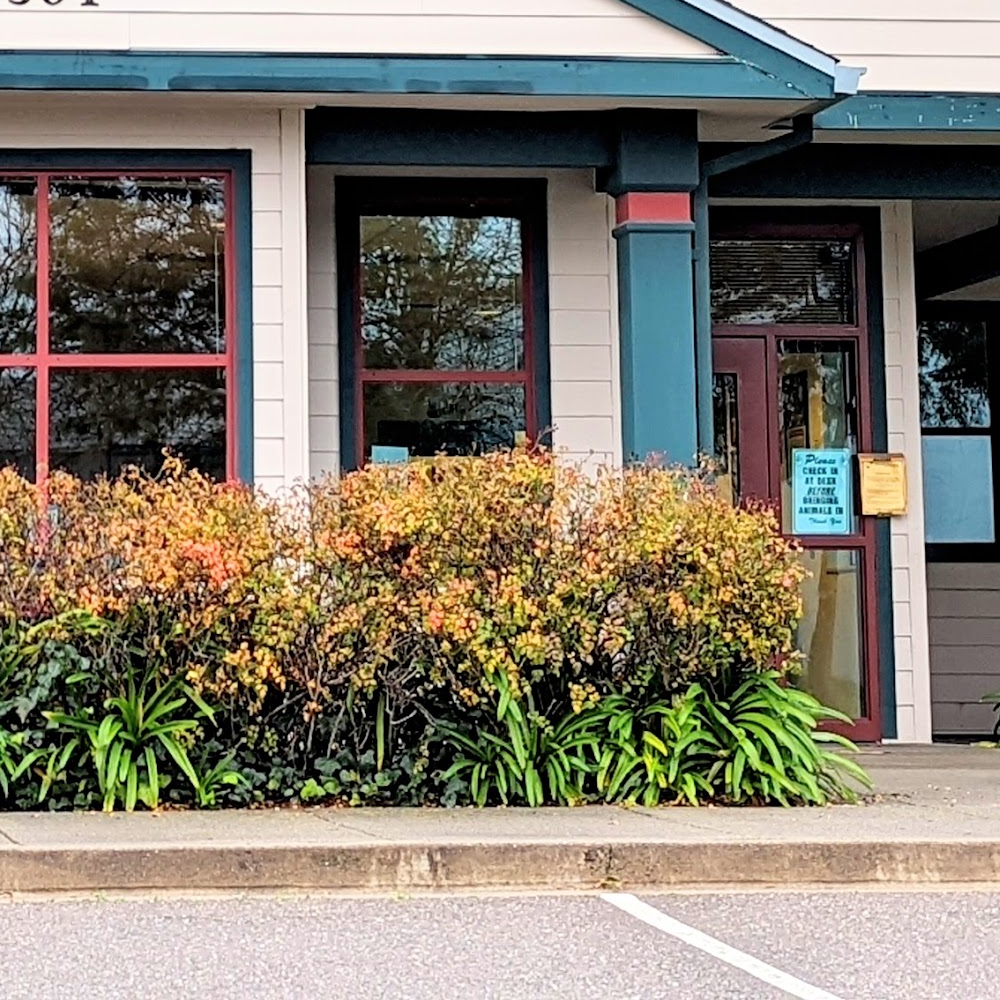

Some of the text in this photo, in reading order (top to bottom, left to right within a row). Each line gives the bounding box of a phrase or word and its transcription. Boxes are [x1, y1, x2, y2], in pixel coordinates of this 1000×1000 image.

[805, 454, 836, 464] Please
[802, 467, 838, 475] CHECK IN
[805, 477, 836, 485] AT DESK
[807, 487, 836, 496] BEFORE
[798, 507, 844, 515] ANIMALS IN
